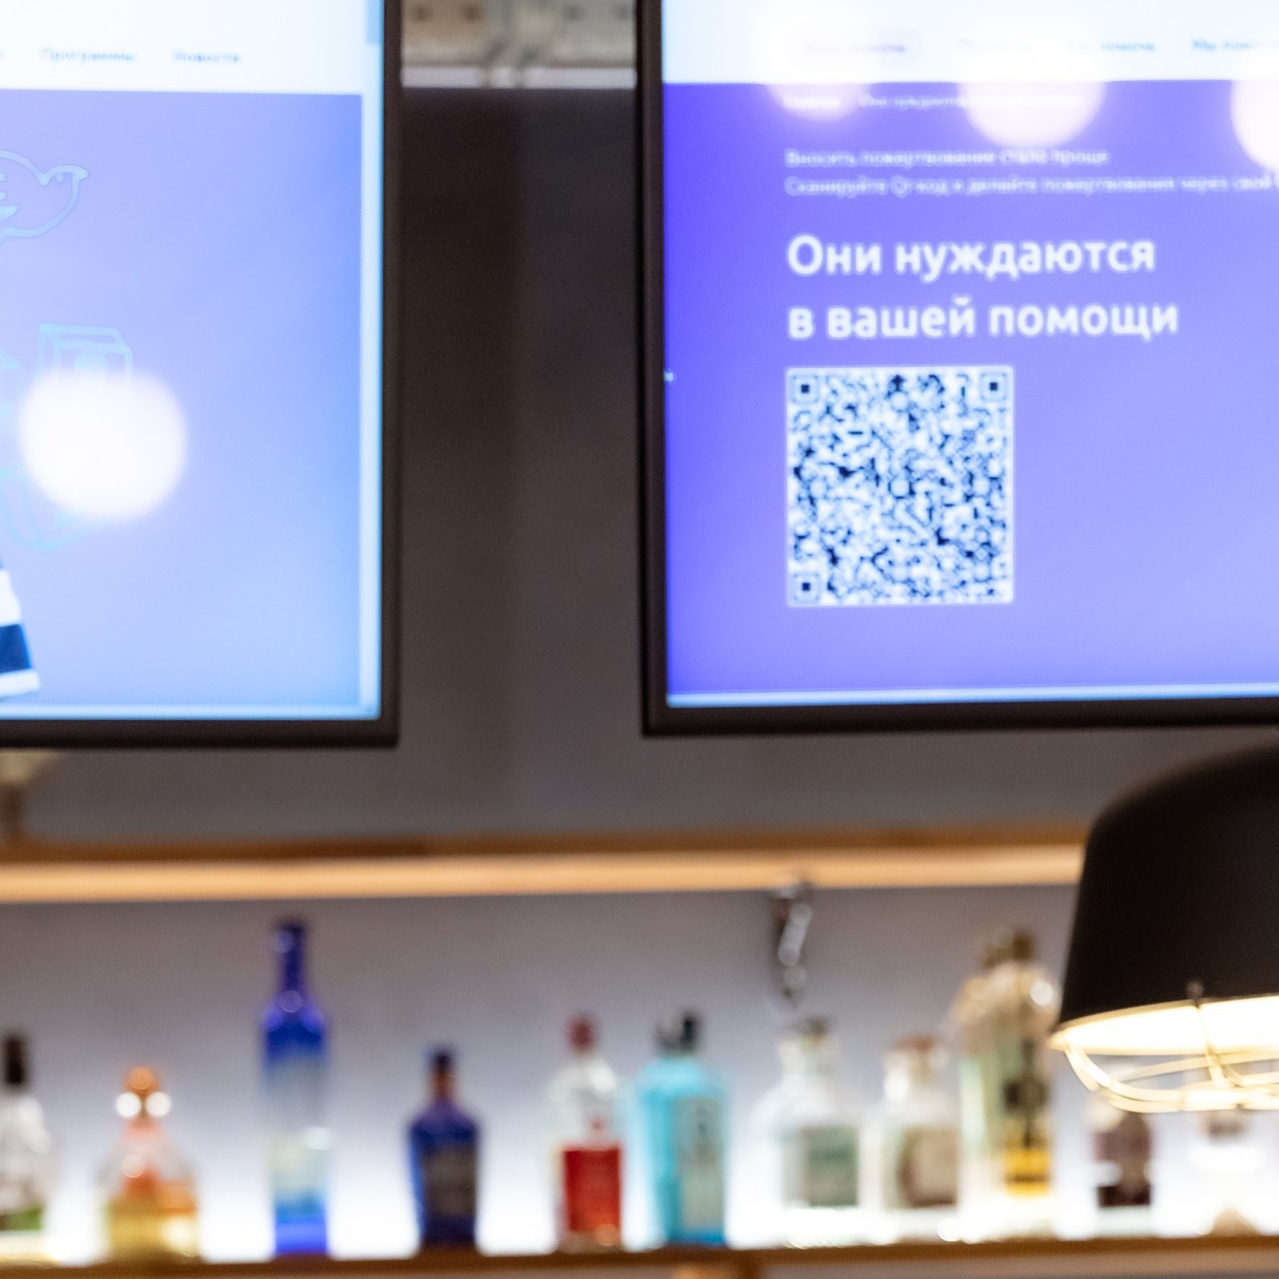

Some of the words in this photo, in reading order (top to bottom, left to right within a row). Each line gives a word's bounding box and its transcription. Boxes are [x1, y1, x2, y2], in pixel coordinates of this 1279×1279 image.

[787, 234, 881, 276] Они
[895, 241, 1155, 282] нуждаются
[788, 307, 814, 339] в
[827, 296, 976, 339] вашей
[989, 305, 1178, 341] помощи
